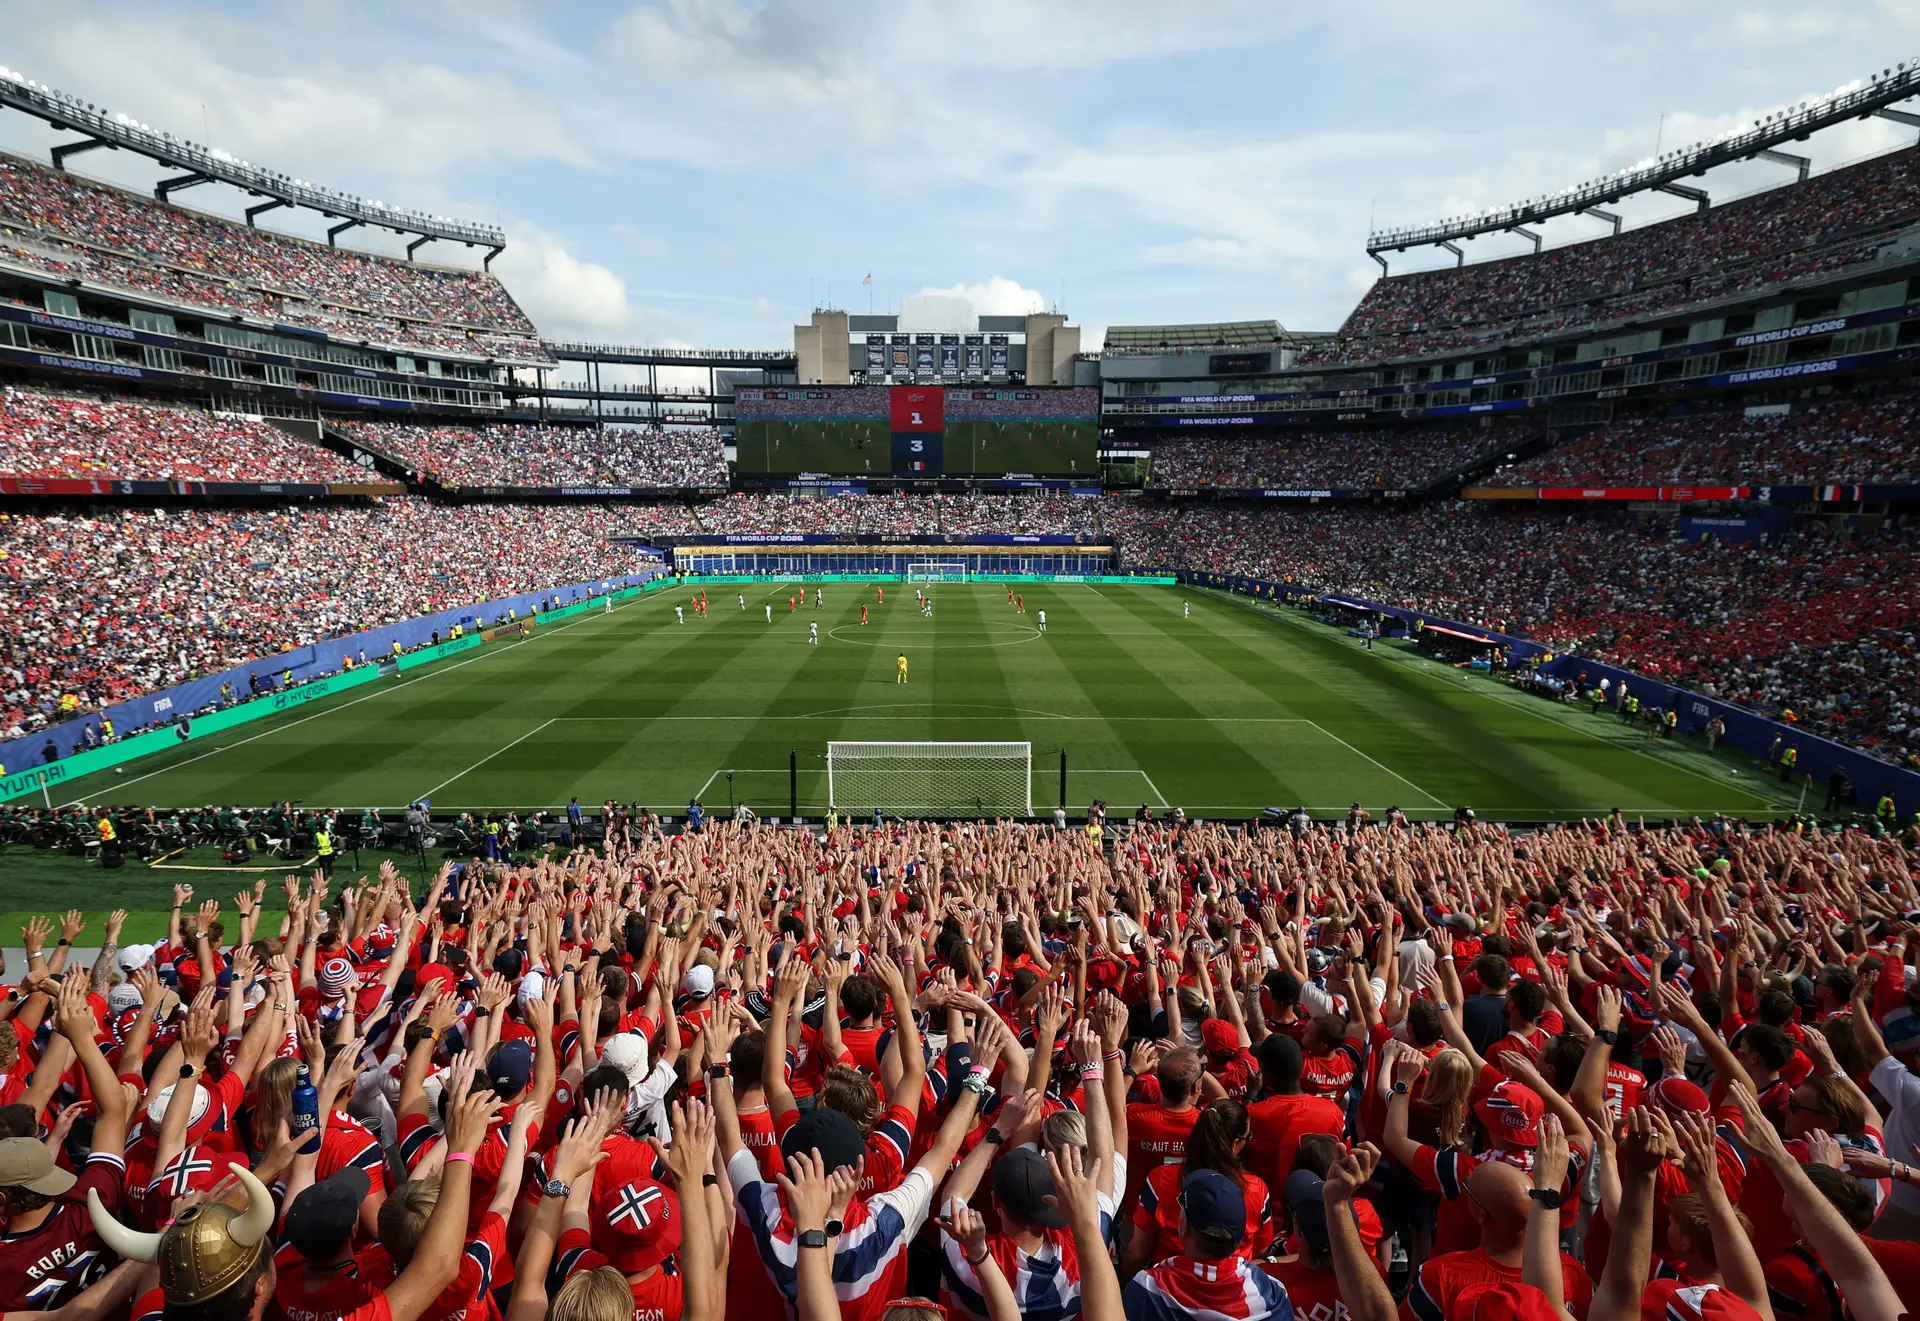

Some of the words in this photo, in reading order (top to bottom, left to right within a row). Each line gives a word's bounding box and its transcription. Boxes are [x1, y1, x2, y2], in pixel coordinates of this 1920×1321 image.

[31, 313, 52, 325] FIFA
[51, 317, 87, 332] WORLD
[86, 323, 105, 335] CUP
[105, 327, 136, 340] 2026
[1735, 336, 1755, 346] FIFA
[1755, 332, 1790, 343] WORLD
[1790, 325, 1811, 337] CUP
[1810, 318, 1847, 334] 2026
[40, 356, 60, 367] FIFA
[60, 359, 95, 372] WORLD
[94, 364, 112, 374] CUP
[112, 366, 142, 378] 2026
[1729, 373, 1749, 383] FIFA
[1749, 369, 1783, 381] WORLD
[1782, 364, 1803, 377] CUP
[1802, 360, 1838, 374] 2026
[911, 412, 923, 424] 1
[910, 440, 924, 452] 3
[90, 480, 101, 493] 1
[121, 481, 133, 493] 3
[1758, 487, 1770, 500] 3
[803, 574, 823, 582] NOW
[1034, 575, 1055, 583] NEXT
[1055, 575, 1084, 583] STARTS
[153, 697, 173, 713] FIFA
[1691, 701, 1710, 717] FIFA
[0, 764, 66, 797] YUNDAI
[1141, 1140, 1170, 1152] BRAUT
